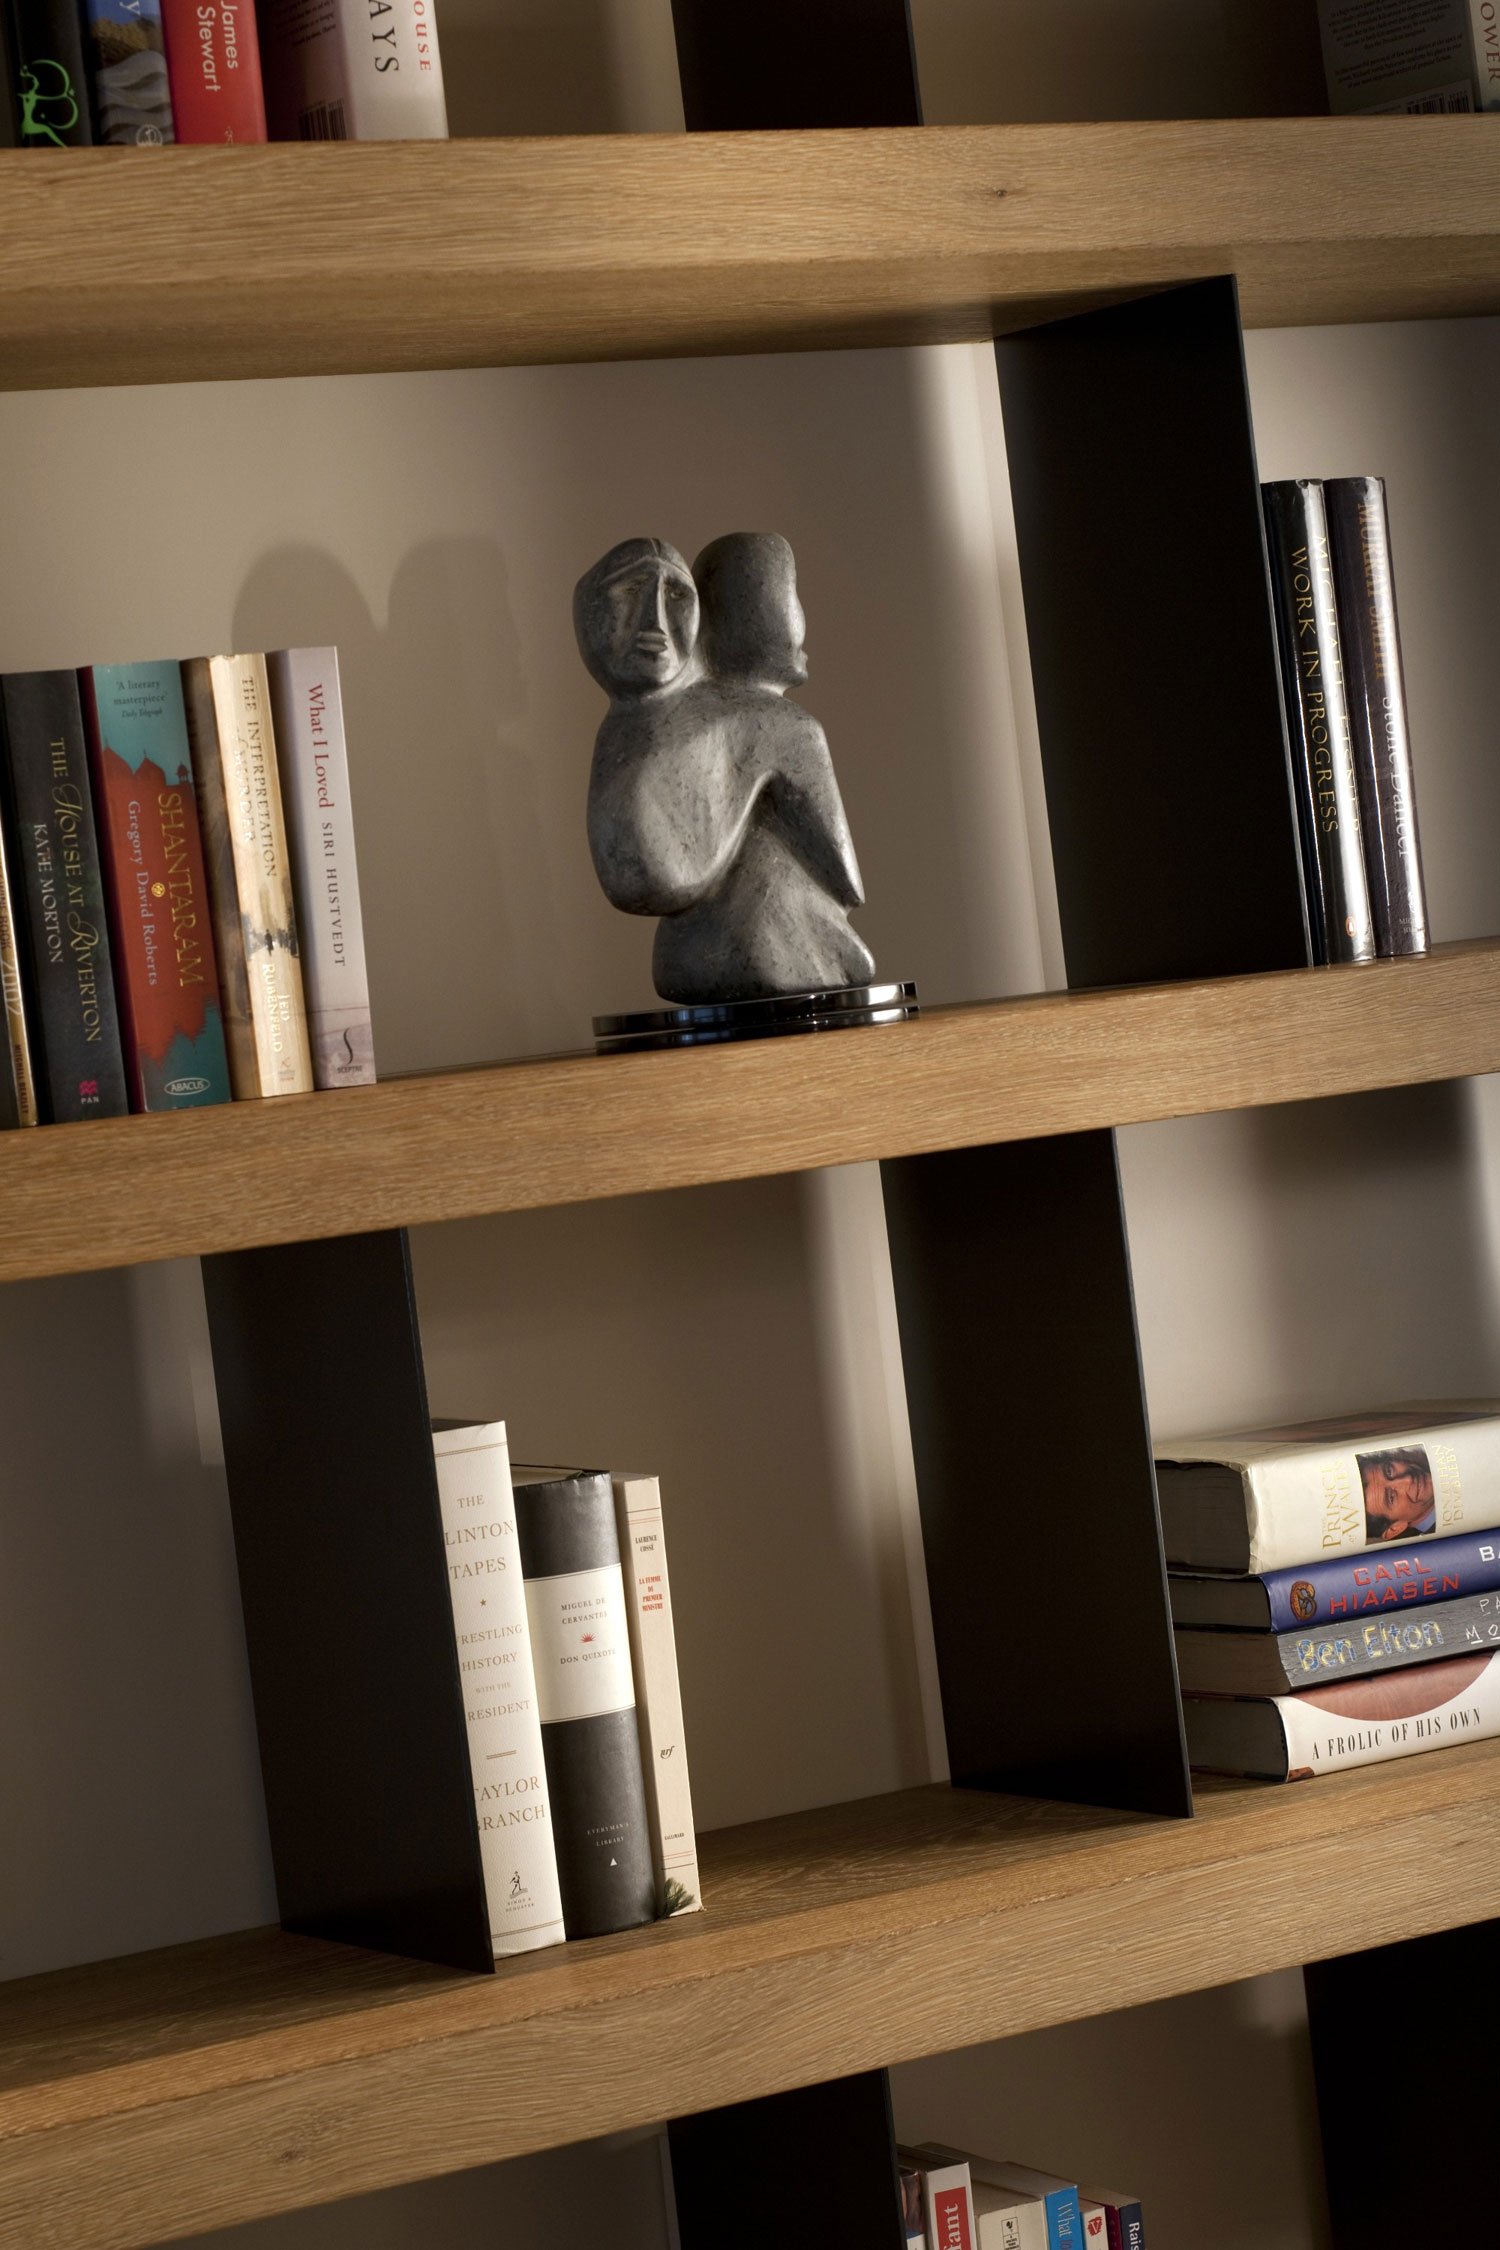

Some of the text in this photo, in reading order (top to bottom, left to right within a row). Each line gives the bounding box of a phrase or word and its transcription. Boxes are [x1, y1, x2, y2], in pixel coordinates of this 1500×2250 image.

[197, 6, 221, 92] Stewart
[221, 0, 238, 69] James
[1358, 503, 1391, 599] MURRAY
[1312, 536, 1343, 686] MICHAEL
[1369, 605, 1398, 680] SMITH
[1292, 546, 1339, 834] WORK IN PROGRESS
[241, 676, 277, 878] THE INTERPRETATION
[308, 684, 346, 967] What I Loved SIRI HUSTVEDT
[34, 824, 63, 963] KATE MORTON
[50, 737, 102, 1042] THE HOUSE AT RIVERTON
[126, 801, 157, 985] Gregory David Roberts
[157, 792, 204, 987] SHANTARAM
[262, 963, 283, 1053] RUBENFELD
[276, 993, 291, 1021] JED
[171, 1080, 205, 1092] ABACUS
[336, 1065, 363, 1074] SCEPTRE
[80, 1095, 99, 1105] PAN
[456, 1494, 485, 1509] THE
[1335, 1458, 1360, 1535] WALES
[1432, 1444, 1454, 1528] JONATHAN
[1443, 1446, 1464, 1521] DIMBLEBY
[1320, 1463, 1341, 1549] PRINCE
[635, 1534, 658, 1544] LAURENCE
[1479, 1545, 1500, 1562] B
[449, 1557, 507, 1580] TAPES
[1353, 1557, 1432, 1587] CARL
[561, 1600, 593, 1611] MIGUEL
[1329, 1573, 1460, 1615] HIAASEN
[457, 1624, 522, 1645] RESTLING
[562, 1611, 608, 1625] CERVANTES
[462, 1652, 518, 1672] HISTORY
[560, 1649, 617, 1665] DON QUIXOTE
[1296, 1621, 1445, 1672] Ben Elton
[475, 1682, 512, 1694] WITH THE
[467, 1700, 531, 1721] RESIDENT
[660, 1745, 675, 1760] nrf
[1312, 1708, 1481, 1760] A FROLIC OF HIS OWN
[477, 1804, 546, 1832] RANCH
[596, 1836, 624, 1847] LIBRARY
[1057, 2202, 1076, 2237] What
